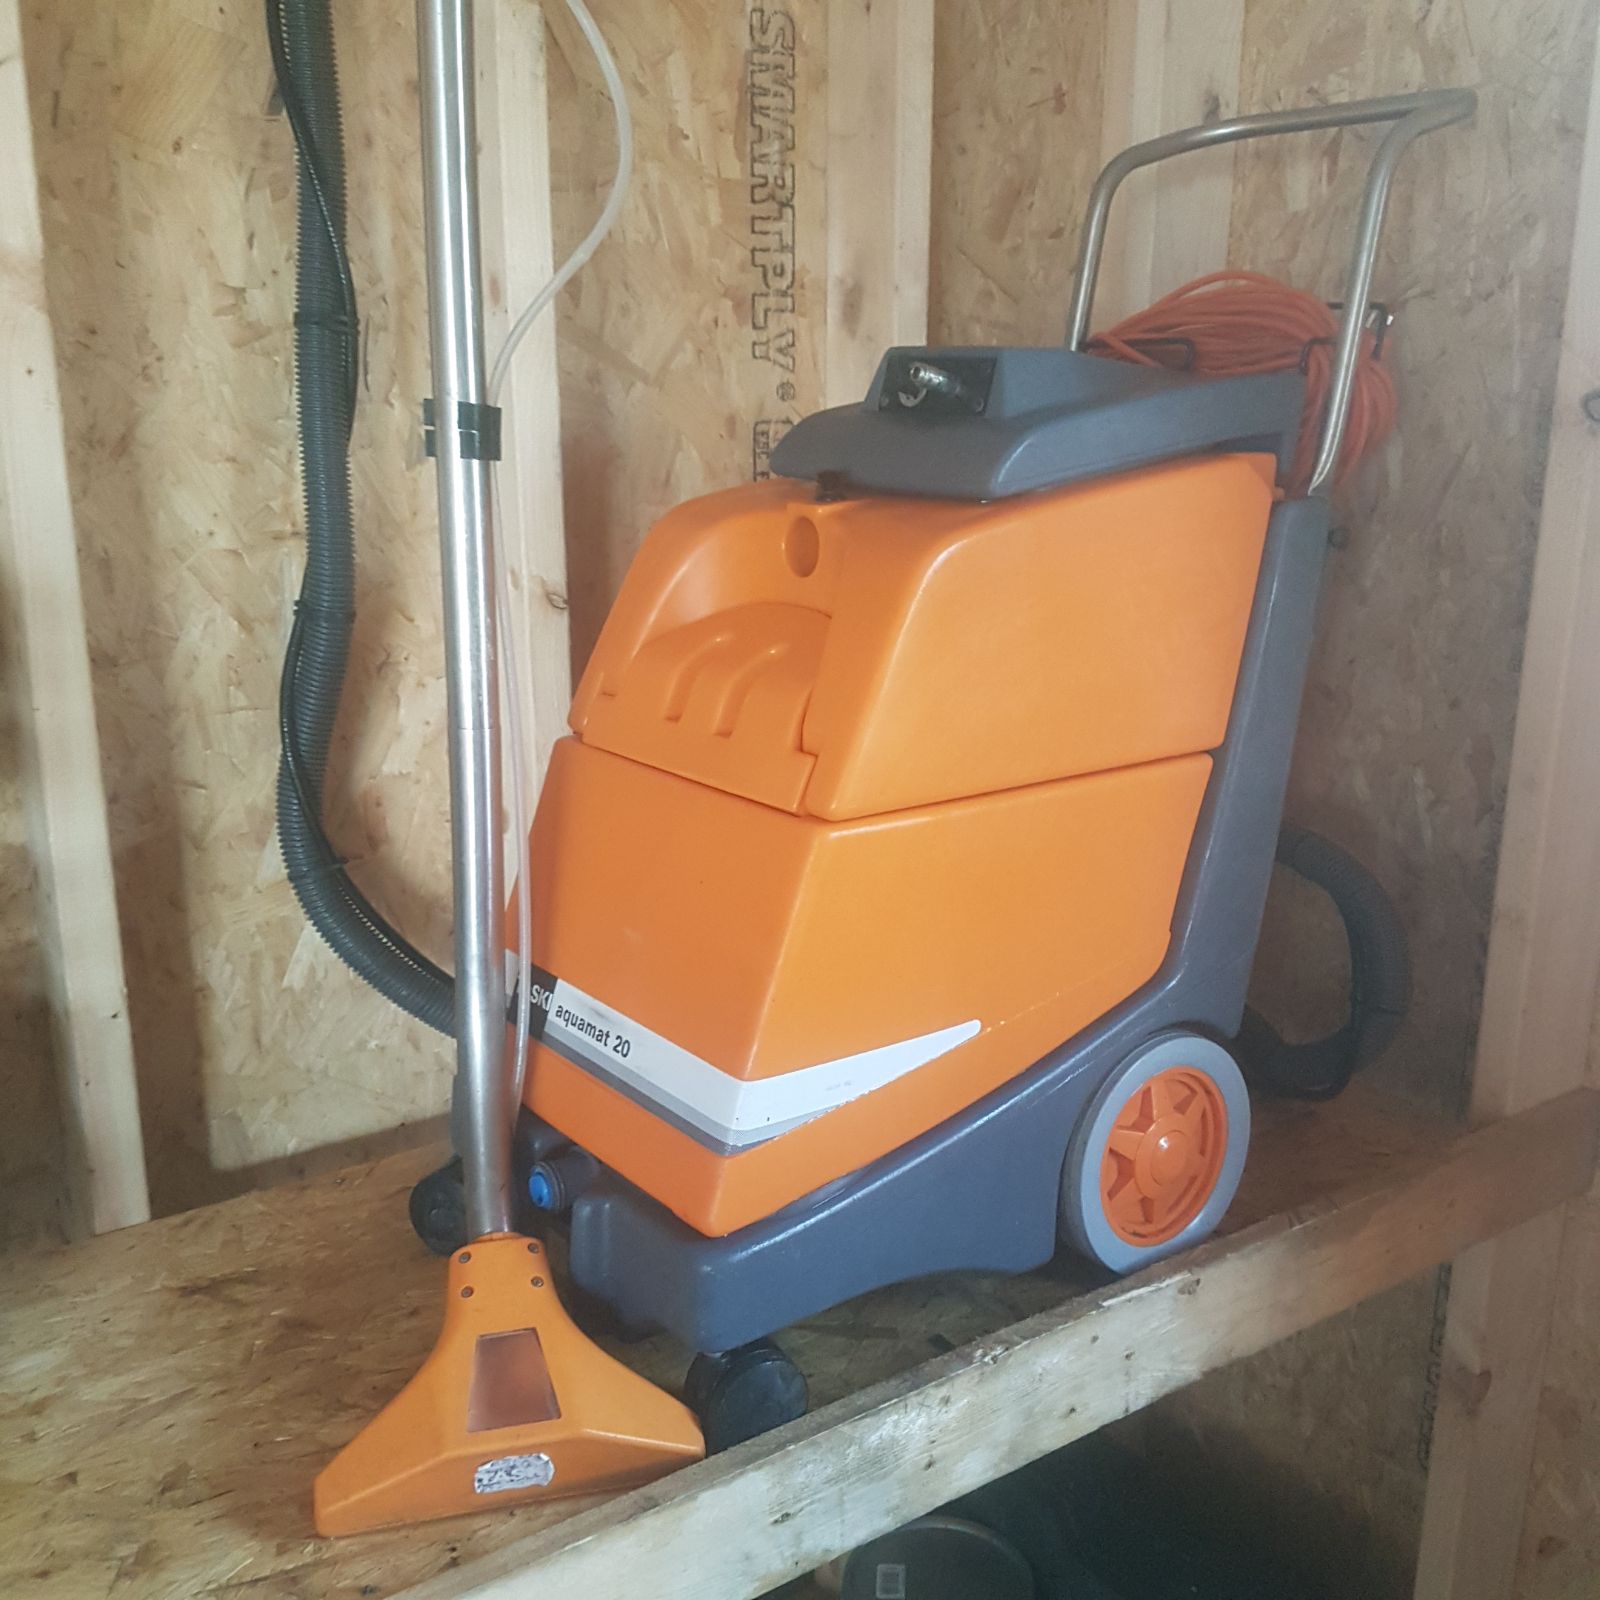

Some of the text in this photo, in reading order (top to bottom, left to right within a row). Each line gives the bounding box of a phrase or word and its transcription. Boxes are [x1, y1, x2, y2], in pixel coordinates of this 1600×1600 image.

[530, 984, 553, 1012] SKI
[555, 1004, 631, 1058] aquamat 20
